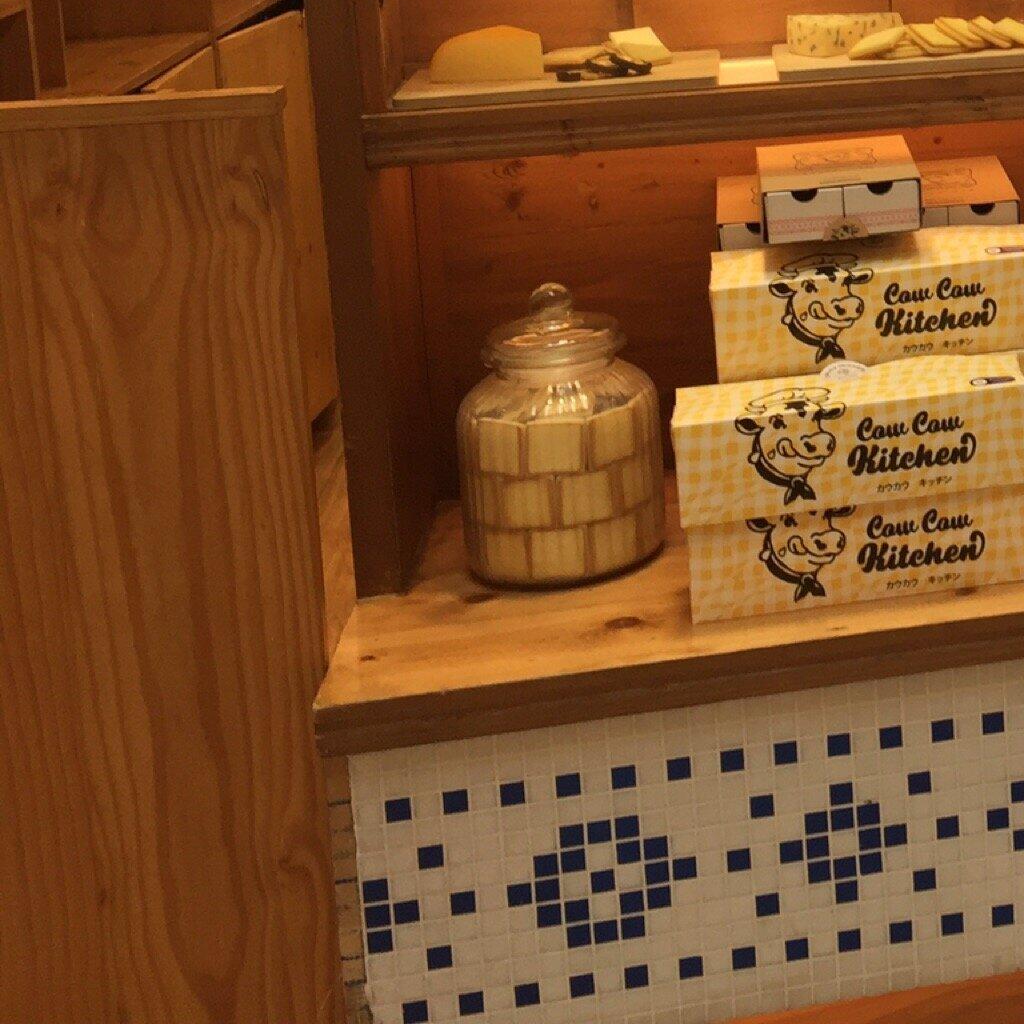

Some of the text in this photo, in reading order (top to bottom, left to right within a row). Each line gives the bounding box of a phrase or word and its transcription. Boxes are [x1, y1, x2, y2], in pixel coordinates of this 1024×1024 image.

[884, 277, 985, 305] Cow Cow
[875, 298, 997, 337] Kitchen
[856, 411, 964, 441] Cow Cow
[847, 432, 977, 476] Kitchen
[866, 508, 973, 539] Cow Cow
[857, 531, 985, 573] Kitchen
